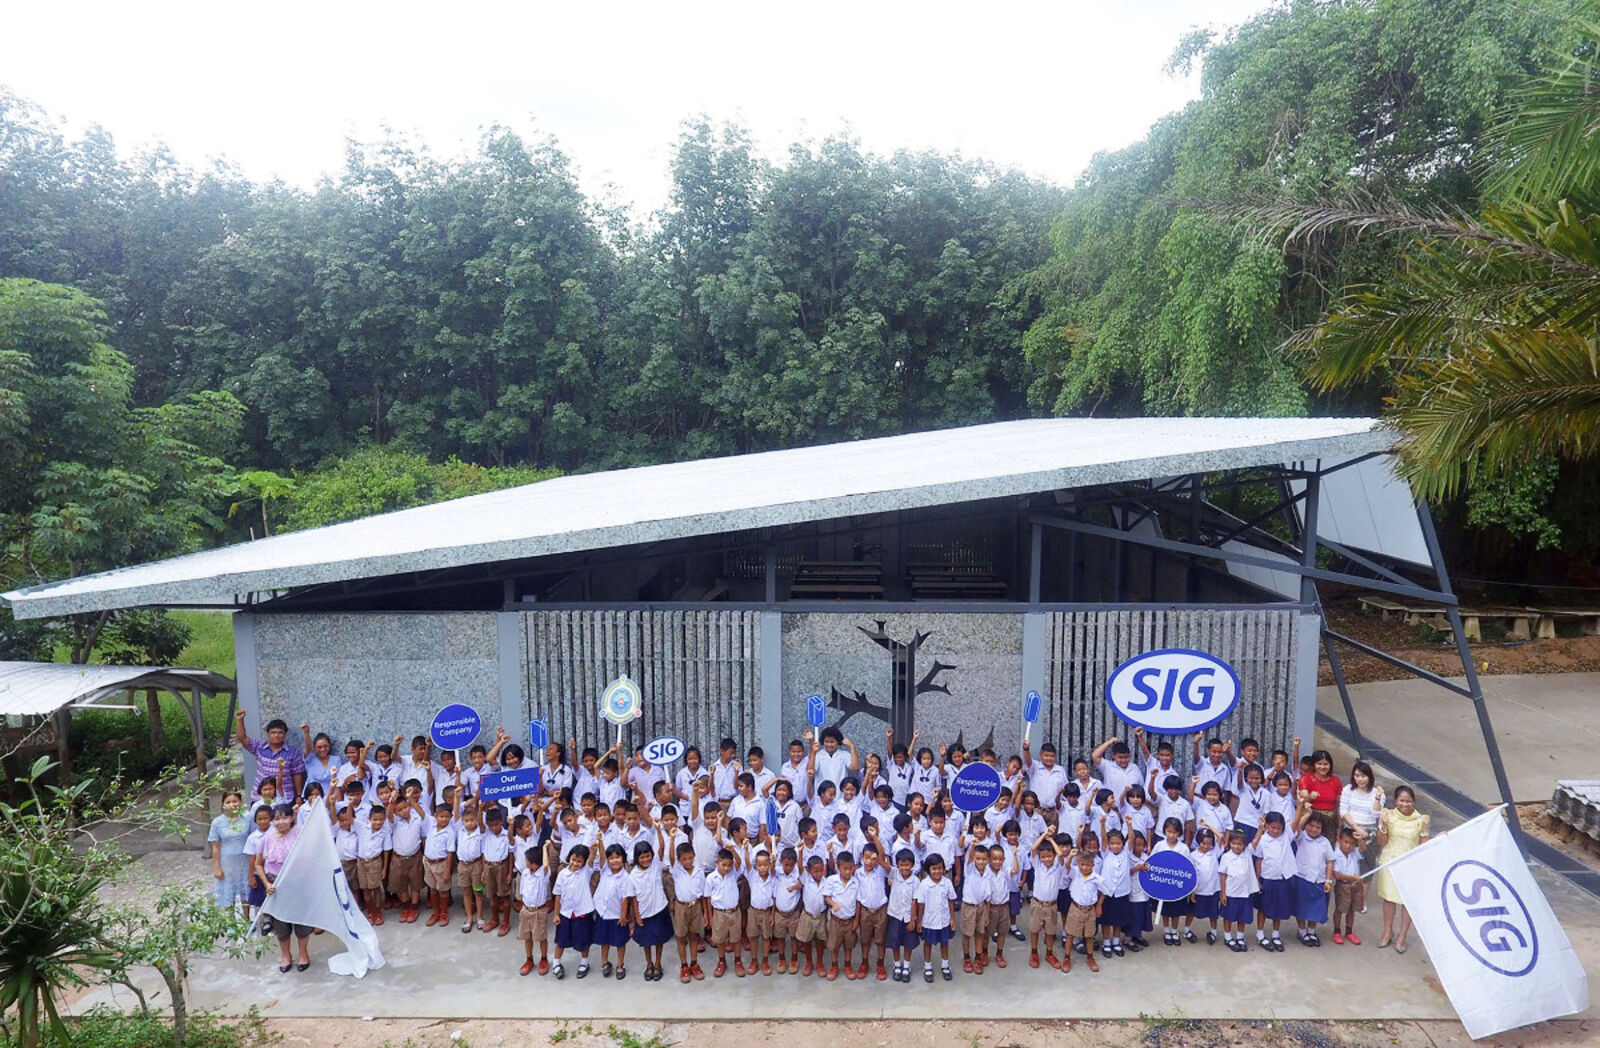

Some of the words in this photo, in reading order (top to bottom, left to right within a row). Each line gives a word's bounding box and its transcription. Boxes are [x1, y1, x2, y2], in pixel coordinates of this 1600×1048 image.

[1127, 667, 1216, 711] SIG
[434, 716, 476, 728] Responsible
[439, 726, 473, 737] Company
[649, 741, 677, 760] SIG
[500, 775, 517, 783] Our
[956, 777, 997, 788] Responsible
[484, 782, 534, 795] Eco-canteen
[959, 787, 989, 797] Products
[1149, 873, 1184, 888] Sourcing
[1453, 878, 1528, 952] SIG
